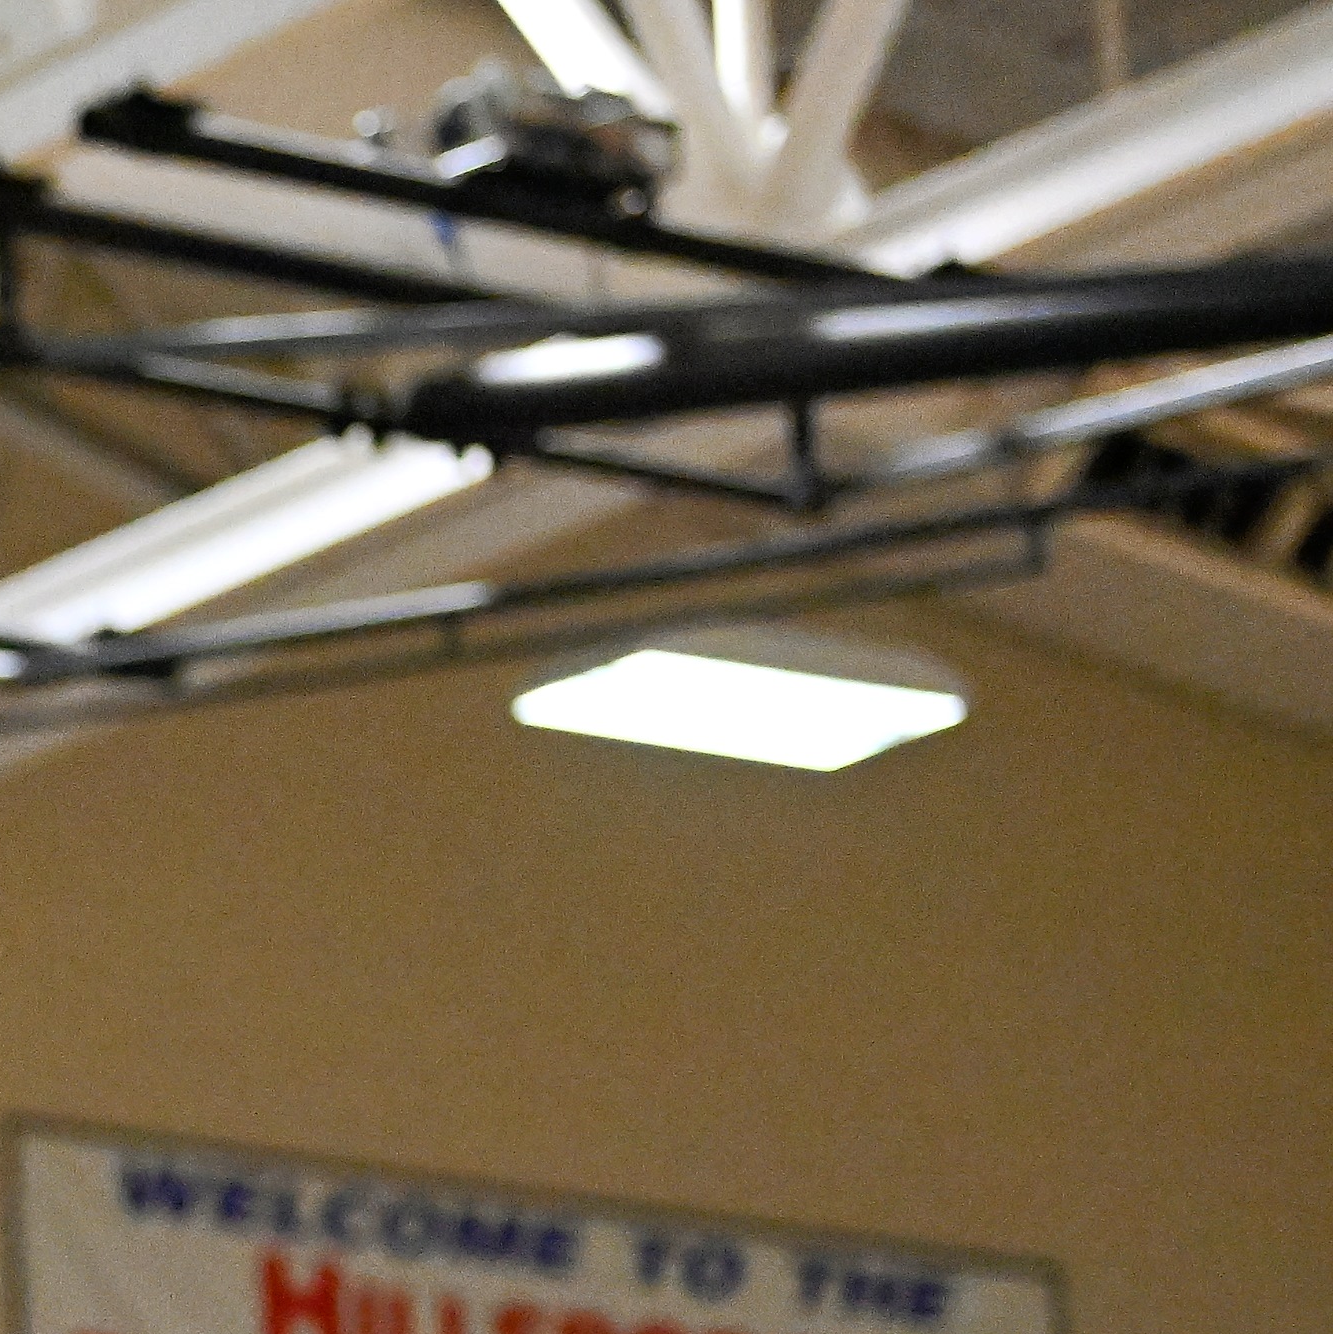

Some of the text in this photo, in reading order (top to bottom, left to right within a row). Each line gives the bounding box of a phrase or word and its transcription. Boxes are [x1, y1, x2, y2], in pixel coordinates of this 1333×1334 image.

[121, 1166, 952, 1330] WELCOME TO THE
